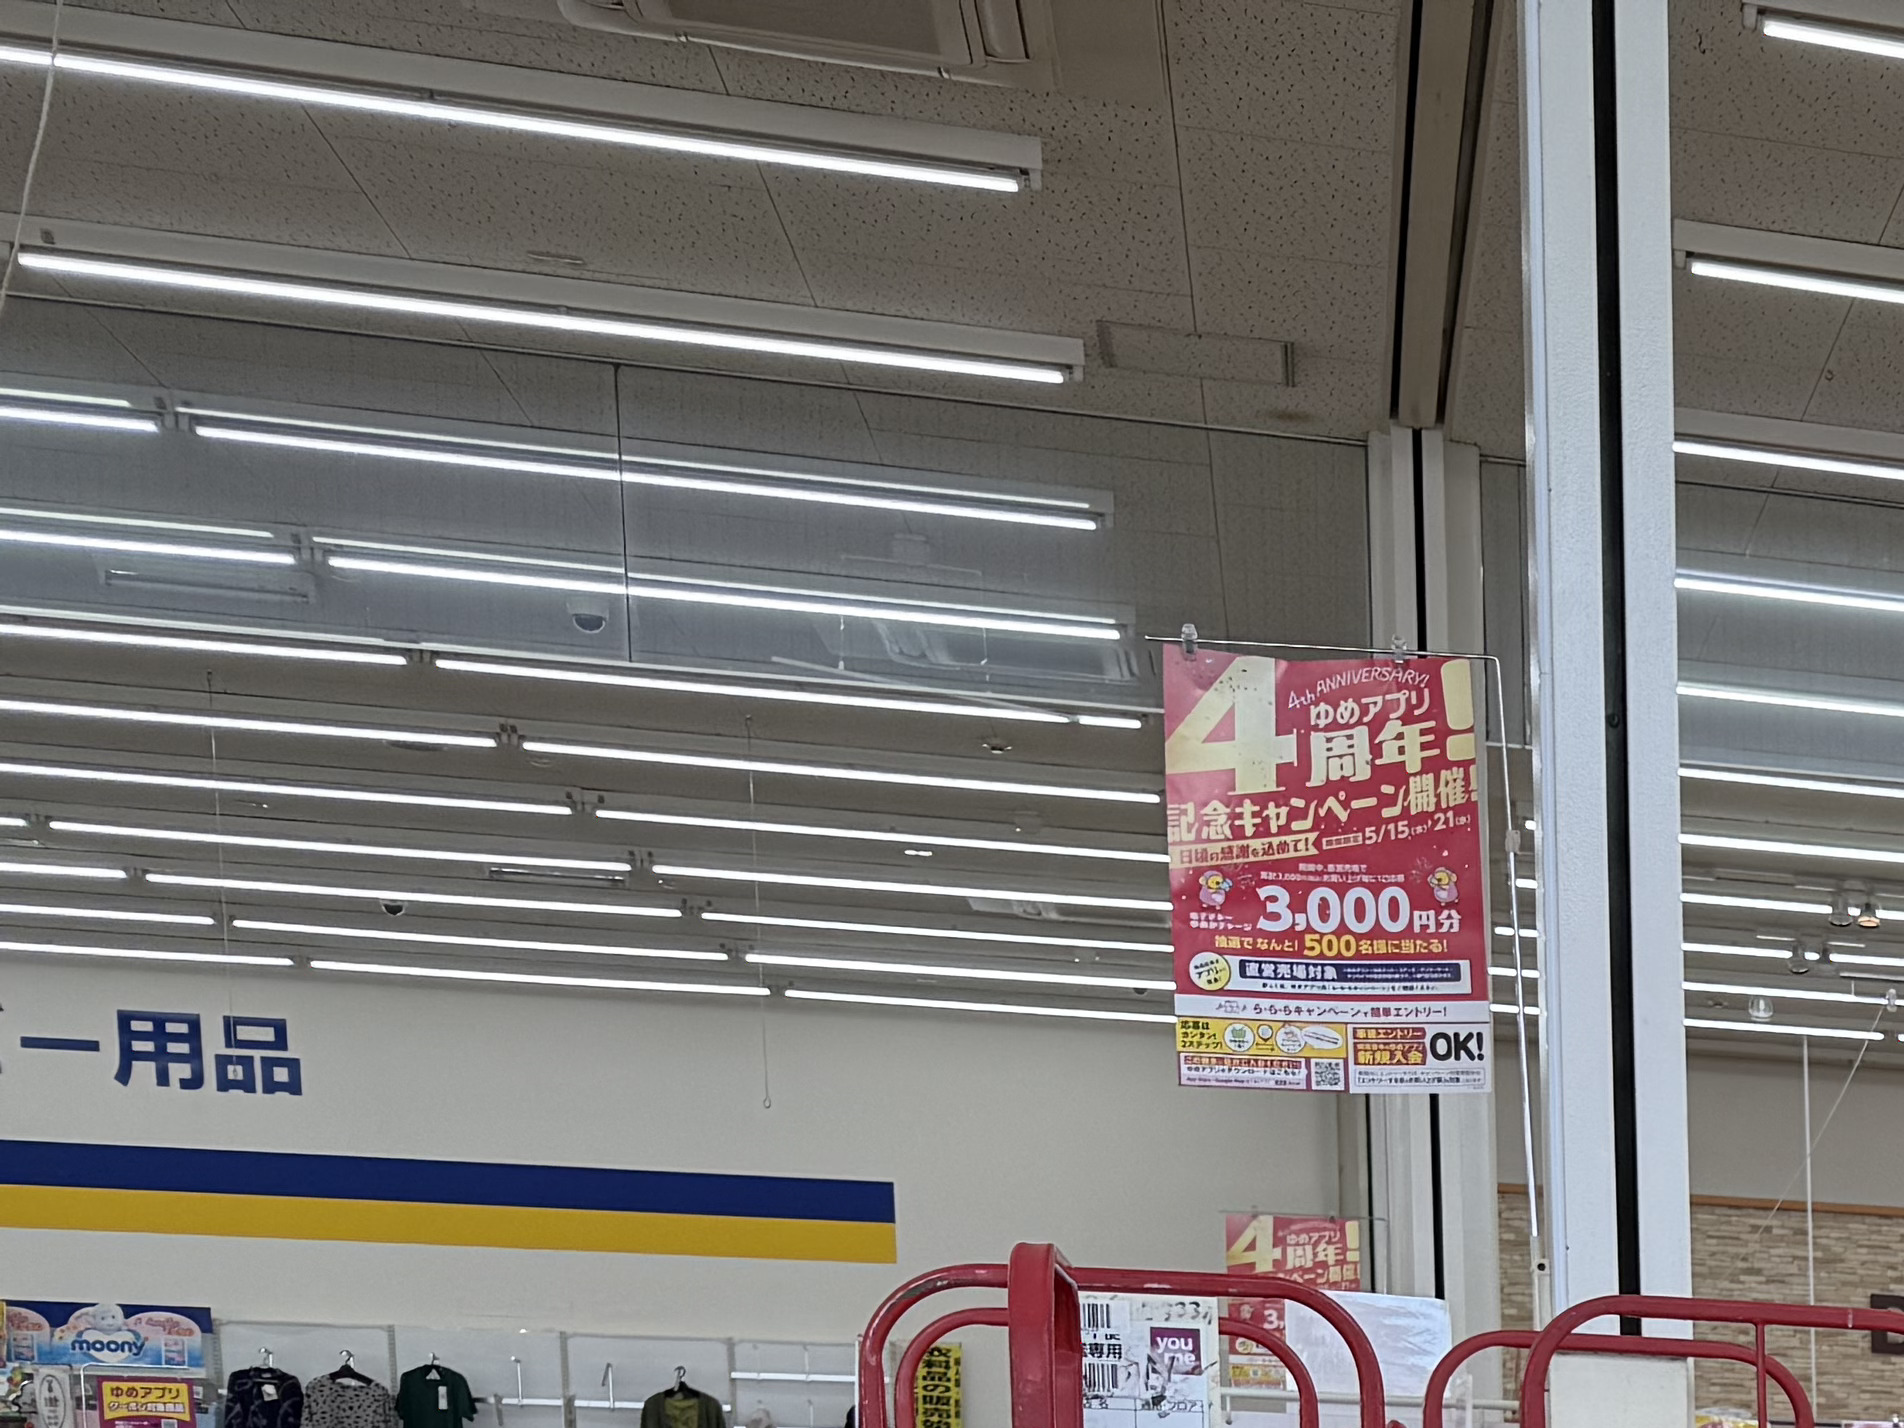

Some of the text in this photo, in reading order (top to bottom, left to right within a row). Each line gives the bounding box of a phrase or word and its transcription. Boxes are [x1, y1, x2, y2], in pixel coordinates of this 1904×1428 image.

[1316, 667, 1430, 699] ANNIVERSARY!
[1310, 688, 1430, 729] ゆめアプリ
[1429, 1032, 1485, 1062] OK!
[71, 1339, 146, 1356] moony
[1156, 1336, 1193, 1352] you
[110, 1386, 180, 1398] ゆめアプリ
